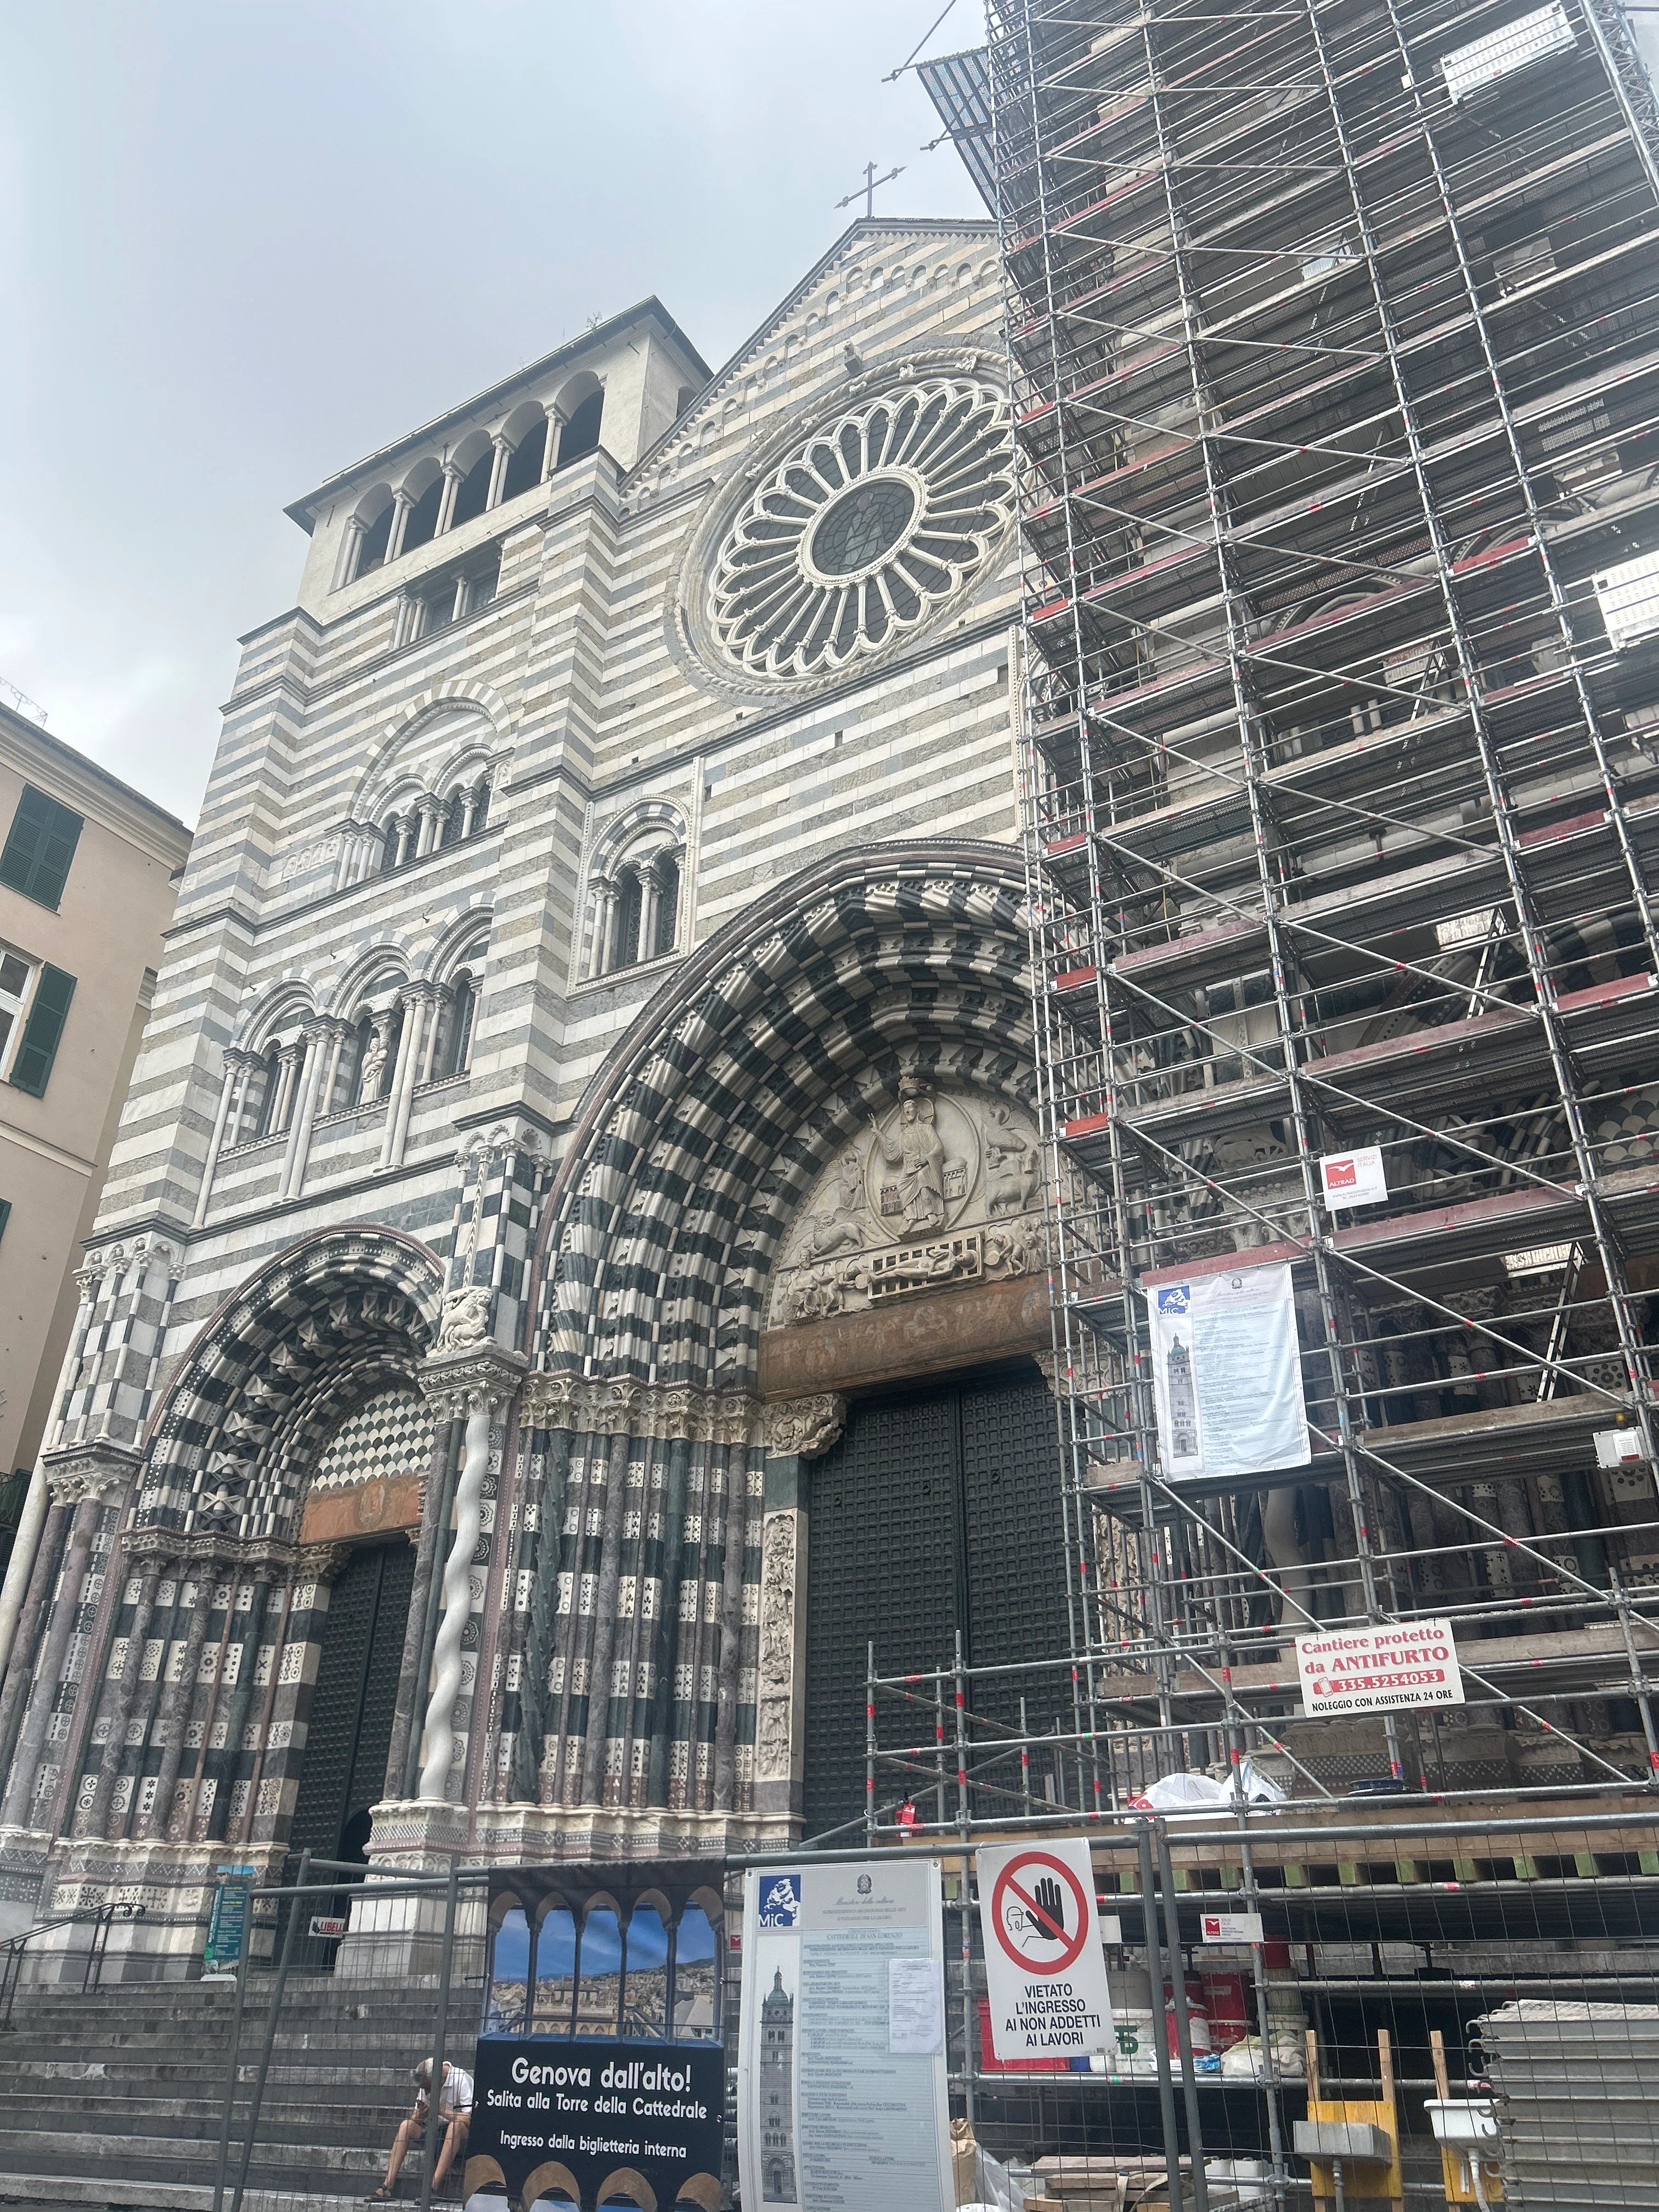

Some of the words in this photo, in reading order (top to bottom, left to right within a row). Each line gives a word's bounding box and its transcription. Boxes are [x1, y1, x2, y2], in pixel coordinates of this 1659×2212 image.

[1329, 1178, 1355, 1187] ALTRAD
[1301, 1637, 1369, 1654] Cantiere
[1374, 1628, 1444, 1649] protetto
[1305, 1661, 1325, 1674] da
[1332, 1646, 1449, 1672] ANTIFURTO
[1339, 1671, 1438, 1692] 335.5254053
[1312, 1699, 1352, 1712] NOLEGGIO
[1355, 1697, 1373, 1707] CON
[1375, 1692, 1421, 1706] ASSISTENZA
[1424, 1691, 1434, 1700] 24
[1436, 1689, 1453, 1700] ORE
[759, 1913, 784, 1927] MiC
[1024, 1983, 1073, 1998] VIETATO
[1015, 1999, 1086, 2015] L'INGRESSO
[1006, 2019, 1017, 2032] AI
[1020, 2017, 1046, 2030] NON
[1050, 2014, 1101, 2029] ADDETTI
[1026, 2034, 1037, 2046] AI
[1040, 2032, 1084, 2046] LAVORI
[511, 2057, 591, 2087] Genova
[600, 2061, 692, 2092] dall'alto!
[487, 2089, 521, 2108] Salita
[527, 2092, 550, 2110] alla
[556, 2092, 588, 2112] Torre
[594, 2096, 627, 2114] della
[633, 2097, 707, 2119] Cattedrale
[500, 2130, 544, 2149] Ingresso
[548, 2134, 575, 2151] dalla
[579, 2136, 640, 2156] biglietteria
[644, 2140, 687, 2158] interna
